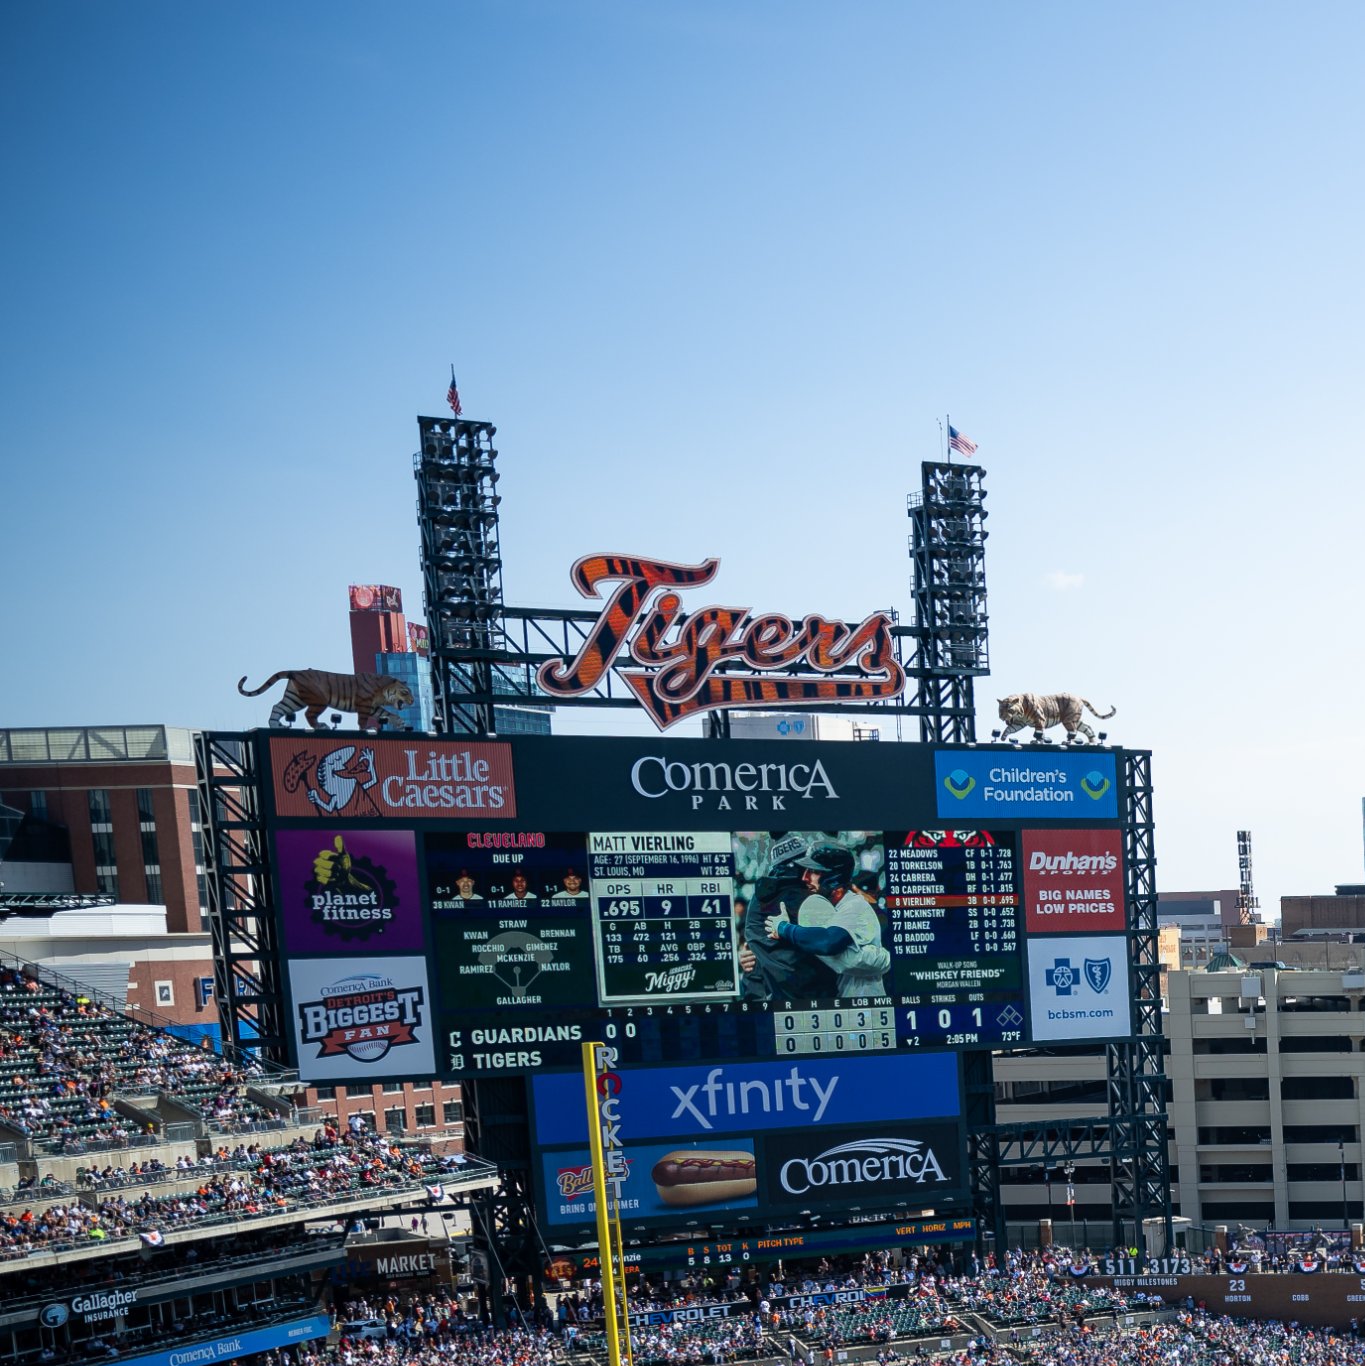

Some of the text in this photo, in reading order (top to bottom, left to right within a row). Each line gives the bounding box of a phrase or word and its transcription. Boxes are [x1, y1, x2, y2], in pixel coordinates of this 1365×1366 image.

[540, 552, 906, 732] Tigers
[404, 750, 489, 781] Little
[990, 768, 1066, 783] Children's
[382, 775, 505, 808] Caesars
[983, 786, 1074, 802] Foundation
[691, 795, 786, 810] PARK
[467, 832, 545, 848] CLEVELAND
[593, 836, 695, 851] MATT VIERLING
[493, 854, 524, 863] DUE UP
[900, 850, 938, 859] MEADOWS
[1029, 851, 1117, 871] Dunham's
[901, 862, 943, 871] TORKELSON
[902, 874, 936, 883] CABRERA
[607, 884, 632, 895] OPS
[657, 884, 674, 894] HR
[701, 884, 721, 893] RBI
[902, 886, 945, 895] CARPENTER
[1039, 889, 1111, 901] BIG NAMES
[312, 891, 377, 909] planet
[902, 898, 936, 907] VIERLING
[322, 905, 392, 920] fitness
[604, 900, 721, 916] .695 41
[904, 910, 946, 919] MCKINSTRY
[1036, 902, 1115, 914] LOW PRICES
[499, 920, 528, 929] STRAW
[904, 921, 931, 930] IBANEZ
[464, 931, 489, 940] KWAN
[540, 929, 576, 938] BRENNAN
[904, 933, 935, 942] BADDOO
[472, 944, 505, 953] ROCCHIO
[906, 945, 928, 954] KELLY
[497, 954, 536, 963] MCKENZIE
[541, 962, 571, 972] NAYLOR
[910, 968, 1005, 981] "WHISKEY FRIENDS"
[369, 977, 393, 988] Bank
[645, 970, 696, 993] Miggy!
[327, 990, 395, 1009] DETROIT'S
[496, 995, 542, 1005] GALLAGHER
[304, 993, 418, 1040] BIGGEST
[1048, 1008, 1114, 1020] bcbsm.com
[344, 1024, 390, 1041] FAN
[471, 1025, 582, 1045] GUARDIANS
[473, 1051, 542, 1069] TIGERS
[670, 1067, 839, 1129] xfinity
[596, 1046, 627, 1199] ROCKET
[560, 1204, 585, 1215] BRING
[896, 1221, 972, 1236] VERT HORIZ MPH
[716, 1238, 804, 1254] TOT PITCH TYPE
[376, 1252, 437, 1276] MARKET
[719, 1254, 732, 1264] 13
[1106, 1258, 1192, 1275] 511 3173
[1113, 1278, 1178, 1287] MIGGY MILESTONES
[1229, 1279, 1246, 1292] 23
[72, 1289, 139, 1314] Gallagher
[1292, 1294, 1310, 1302] COBB
[84, 1306, 130, 1324] INSURANCE
[216, 1338, 242, 1355] Bank
